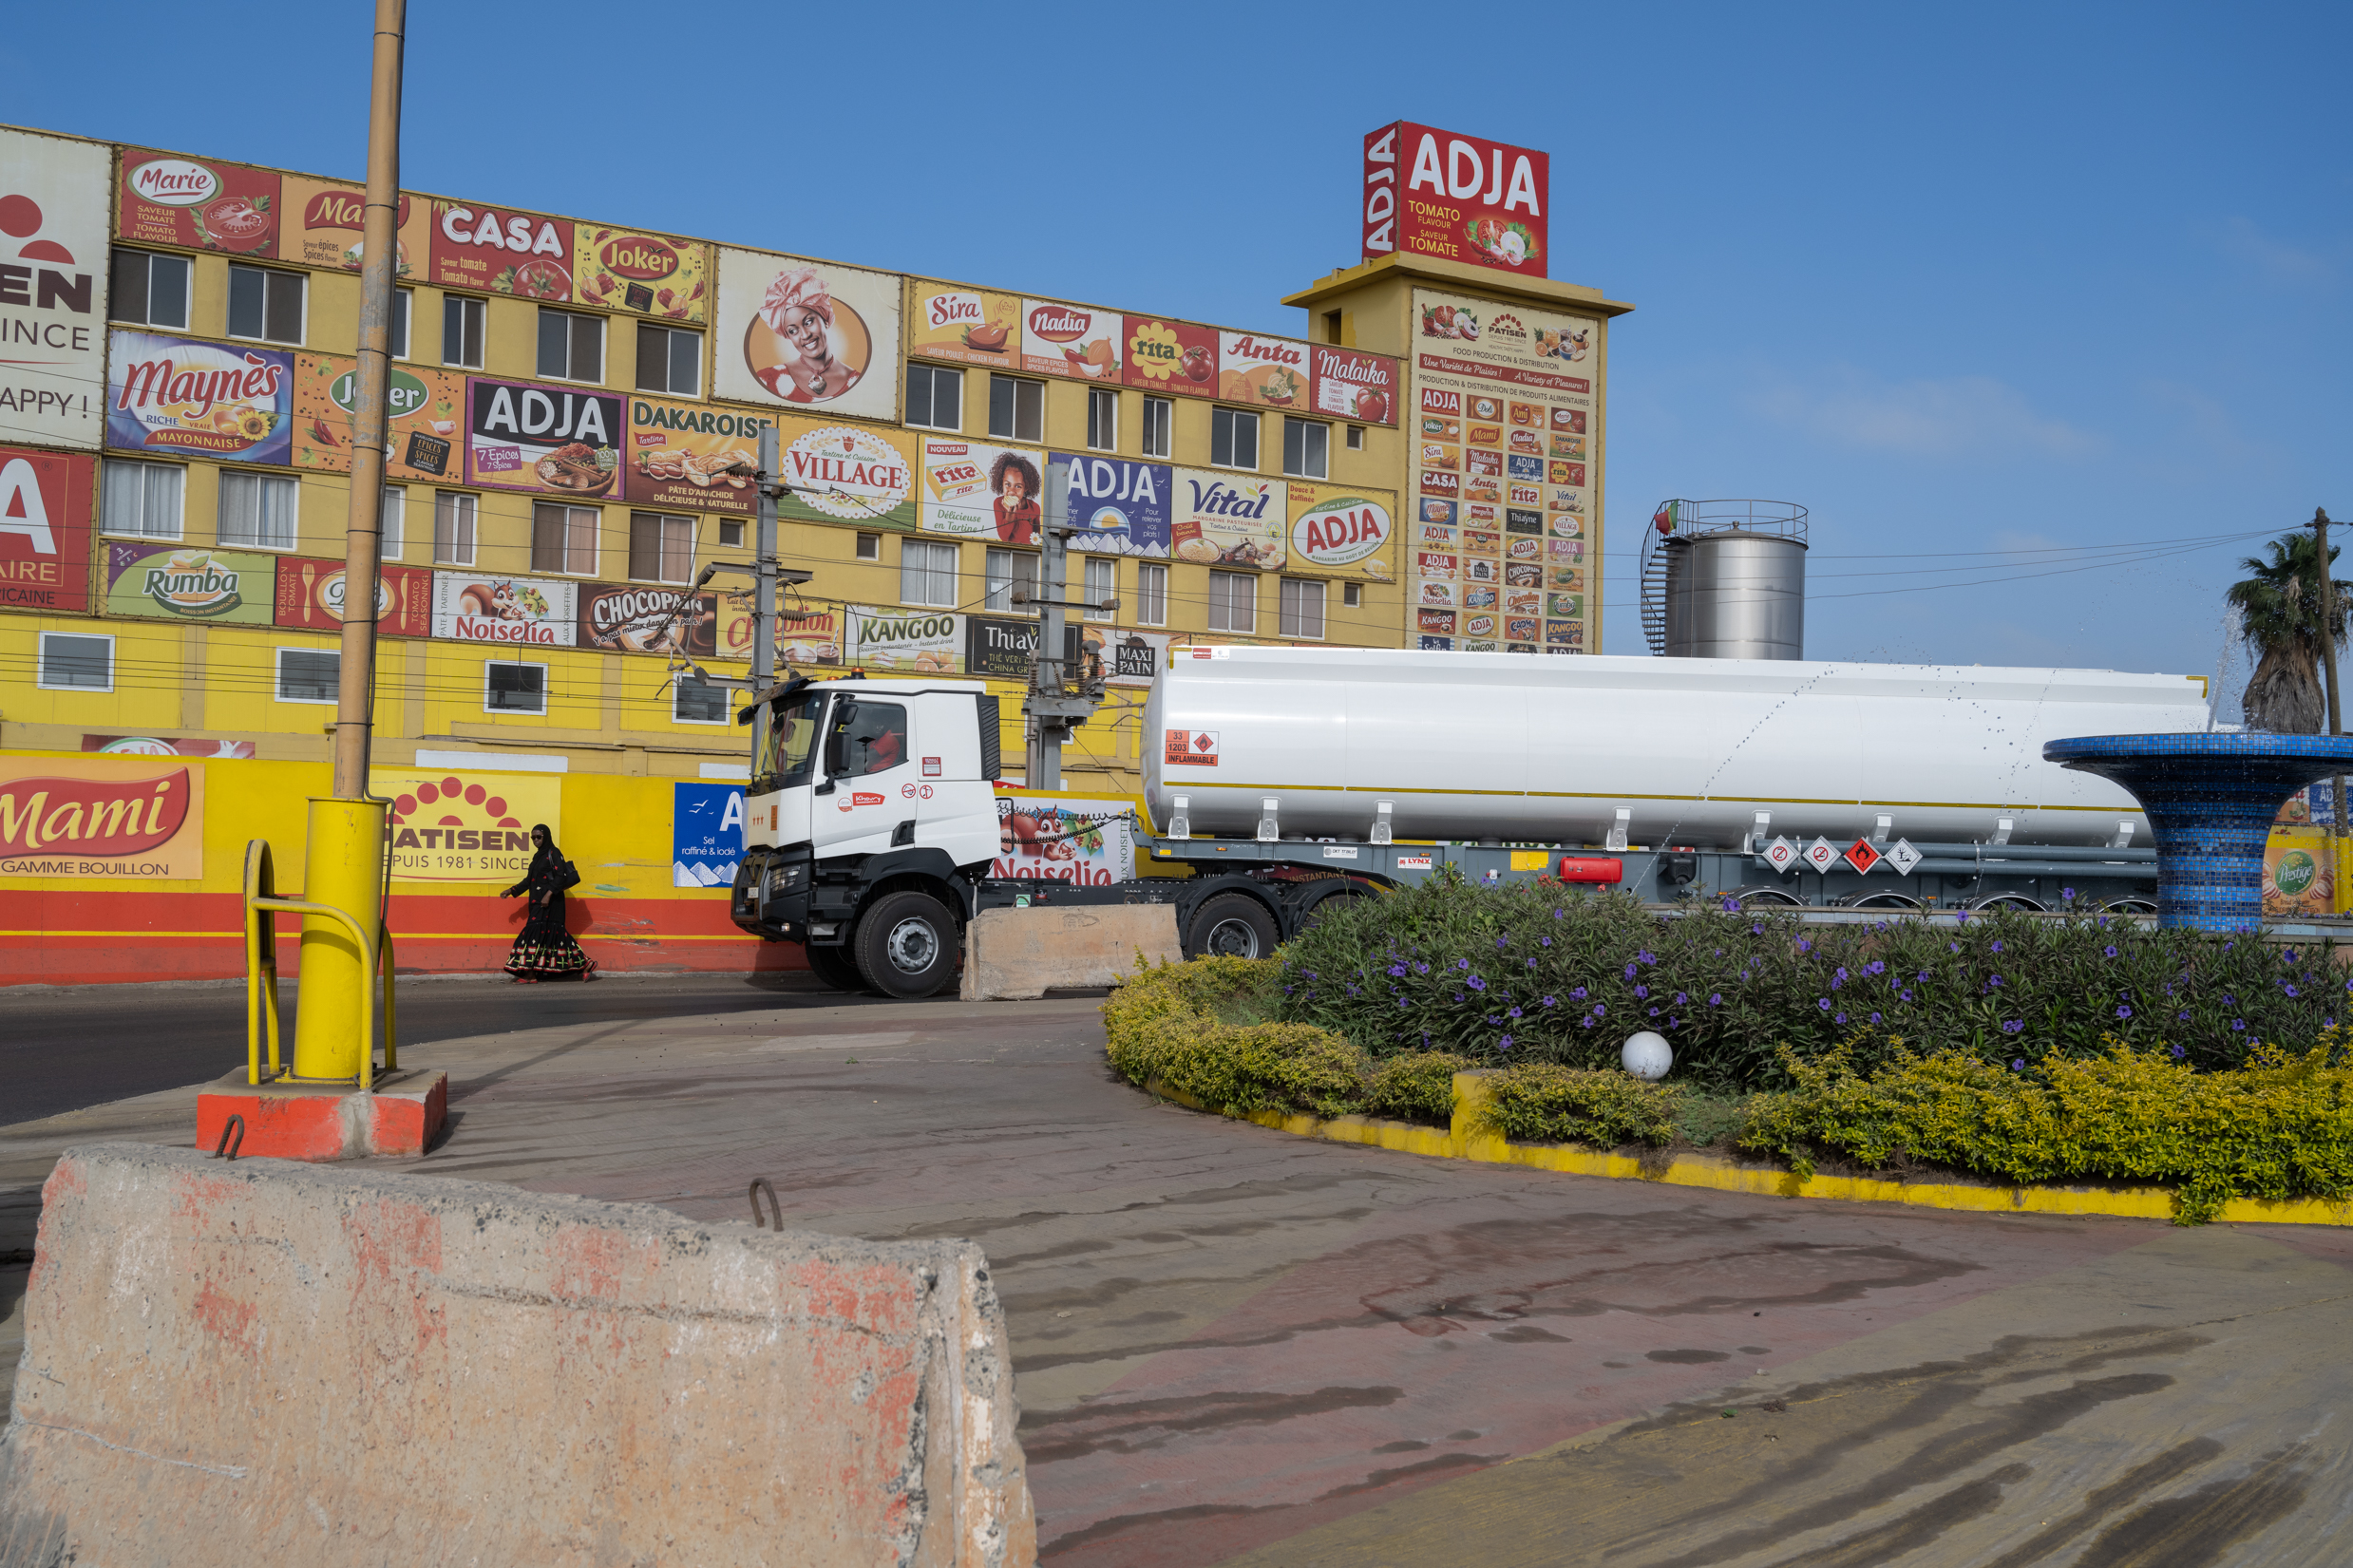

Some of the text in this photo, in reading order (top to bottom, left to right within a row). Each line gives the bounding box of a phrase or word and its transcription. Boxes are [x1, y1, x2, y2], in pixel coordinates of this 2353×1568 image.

[140, 168, 212, 193] Marie
[1408, 133, 1541, 217] ADJA
[1366, 127, 1395, 252] ADJA
[137, 205, 176, 217] SAVEUR
[1408, 199, 1461, 221] TOMATO
[137, 213, 176, 225] TOMATE
[1417, 216, 1452, 229] FLAVOUR
[136, 223, 177, 236] TOMATO
[442, 208, 564, 258] CASA
[1419, 229, 1449, 242] SAVEUR
[133, 232, 179, 244] FLAVOUR
[317, 239, 339, 253] épices
[1409, 236, 1458, 257] TOMATE
[303, 247, 325, 261] Spices
[607, 243, 674, 274] Joker
[440, 255, 487, 272] Saveur tomate
[440, 269, 485, 287] Tomato flavor
[932, 296, 980, 326] Sira
[1034, 312, 1086, 331] Nadia
[2, 318, 90, 351] INCE
[1489, 326, 1527, 339] PATISEN
[1137, 337, 1176, 360] rita
[1227, 336, 1301, 365] Anta
[926, 349, 944, 357] SAVEUR
[967, 353, 987, 363] CHICKEN
[988, 356, 1010, 366] FLAVOUR
[1027, 356, 1069, 368] SAVEUR EPICES
[1452, 347, 1559, 370] FOOD PRODUCTION DISTRIBUTION
[1045, 366, 1070, 375] FLAVOUR
[1423, 356, 1498, 376] Une Variété de Plaisirs
[118, 352, 283, 420] Maynès
[1131, 377, 1210, 396] SAVEUR TOMATE TOMATO FLAVOUR
[1522, 372, 1583, 389] Variety of Pleasures
[1328, 387, 1344, 396] TOMATE
[1418, 373, 1590, 406] PRODUCTION DISTRIBUTION DE PRODUITS ALIMENTAIRES
[1328, 396, 1344, 405] TOMATO
[1423, 389, 1459, 410] ADJA
[145, 414, 180, 426] RICHE
[484, 386, 608, 444] ADJA
[1512, 407, 1528, 420] Ami
[189, 422, 212, 431] VRAIE
[1424, 421, 1443, 431] Joker
[156, 431, 241, 449] MAYONNAISE
[638, 435, 664, 444] Tartine
[1471, 429, 1498, 441] Mami
[1512, 432, 1533, 443] Nadia
[1555, 435, 1582, 444] DAKAROISE
[417, 439, 443, 454] EPICES
[1425, 446, 1442, 459] Sira
[414, 449, 439, 464] SPICES
[478, 448, 520, 464] 7 Epices
[821, 449, 877, 463] Tartine Cuisine
[1516, 457, 1536, 469] ADJA
[492, 461, 513, 471] Spices
[788, 450, 902, 490] VILLAGE
[1552, 468, 1567, 477] rita
[935, 465, 977, 483] rita
[1068, 457, 1158, 505] ADJA
[1421, 472, 1458, 489] CASA
[1289, 484, 1309, 494] Douce
[1469, 477, 1498, 489] Anta
[668, 485, 734, 500] PÂTE D'ARACHIDE
[1187, 479, 1271, 520] Vital
[1289, 493, 1315, 503] Raffinée
[1510, 486, 1538, 503] rita
[1556, 490, 1577, 501] Vital
[0, 458, 57, 555] A
[654, 493, 749, 510] DÉLICIEUSE NATURELLE
[1315, 499, 1363, 513] tartine cuisine
[1145, 507, 1159, 516] Pour
[946, 521, 977, 534] Tartine
[1192, 515, 1262, 528] MARGARINE PASTEURISÉE
[1555, 521, 1578, 531] VILLAGE
[1306, 508, 1382, 555] ADJA
[1424, 526, 1450, 540] ADJA
[1513, 541, 1536, 556] ADJA
[1555, 540, 1578, 553] ADJA
[1425, 554, 1450, 568] ADJA
[143, 566, 238, 598] Rumba
[278, 566, 288, 616] BOUILLON
[288, 571, 296, 613] TOMATE
[441, 575, 449, 610] TARTINER
[411, 580, 420, 623] TOMATO
[420, 574, 429, 632] SEASONING
[562, 586, 572, 626] NOISETTES
[1422, 595, 1452, 606] Noiselia
[1468, 594, 1494, 605] KANGOO
[1421, 614, 1452, 626] KANGOO
[1471, 618, 1492, 633] ADJA
[1547, 621, 1583, 634] KANGOO
[456, 615, 556, 644] Noiselia
[608, 631, 621, 643] pas
[859, 615, 955, 645] KANGOO
[880, 643, 913, 652] instantanée
[1119, 647, 1152, 662] MAXI
[989, 652, 1003, 663] THÉ
[988, 663, 1015, 673] CHINA
[1119, 660, 1152, 675] PAIN
[1172, 731, 1183, 741] 33
[1167, 744, 1187, 752] 1203
[1167, 755, 1215, 765] INFLAMMABLE
[0, 780, 171, 850] Mami
[703, 836, 715, 844] Sel
[681, 845, 736, 856] raffiné iodé
[1, 860, 169, 876] GAMME BOUILLON
[437, 856, 529, 871] 1981 SINCE
[2278, 864, 2313, 884] Prestige
